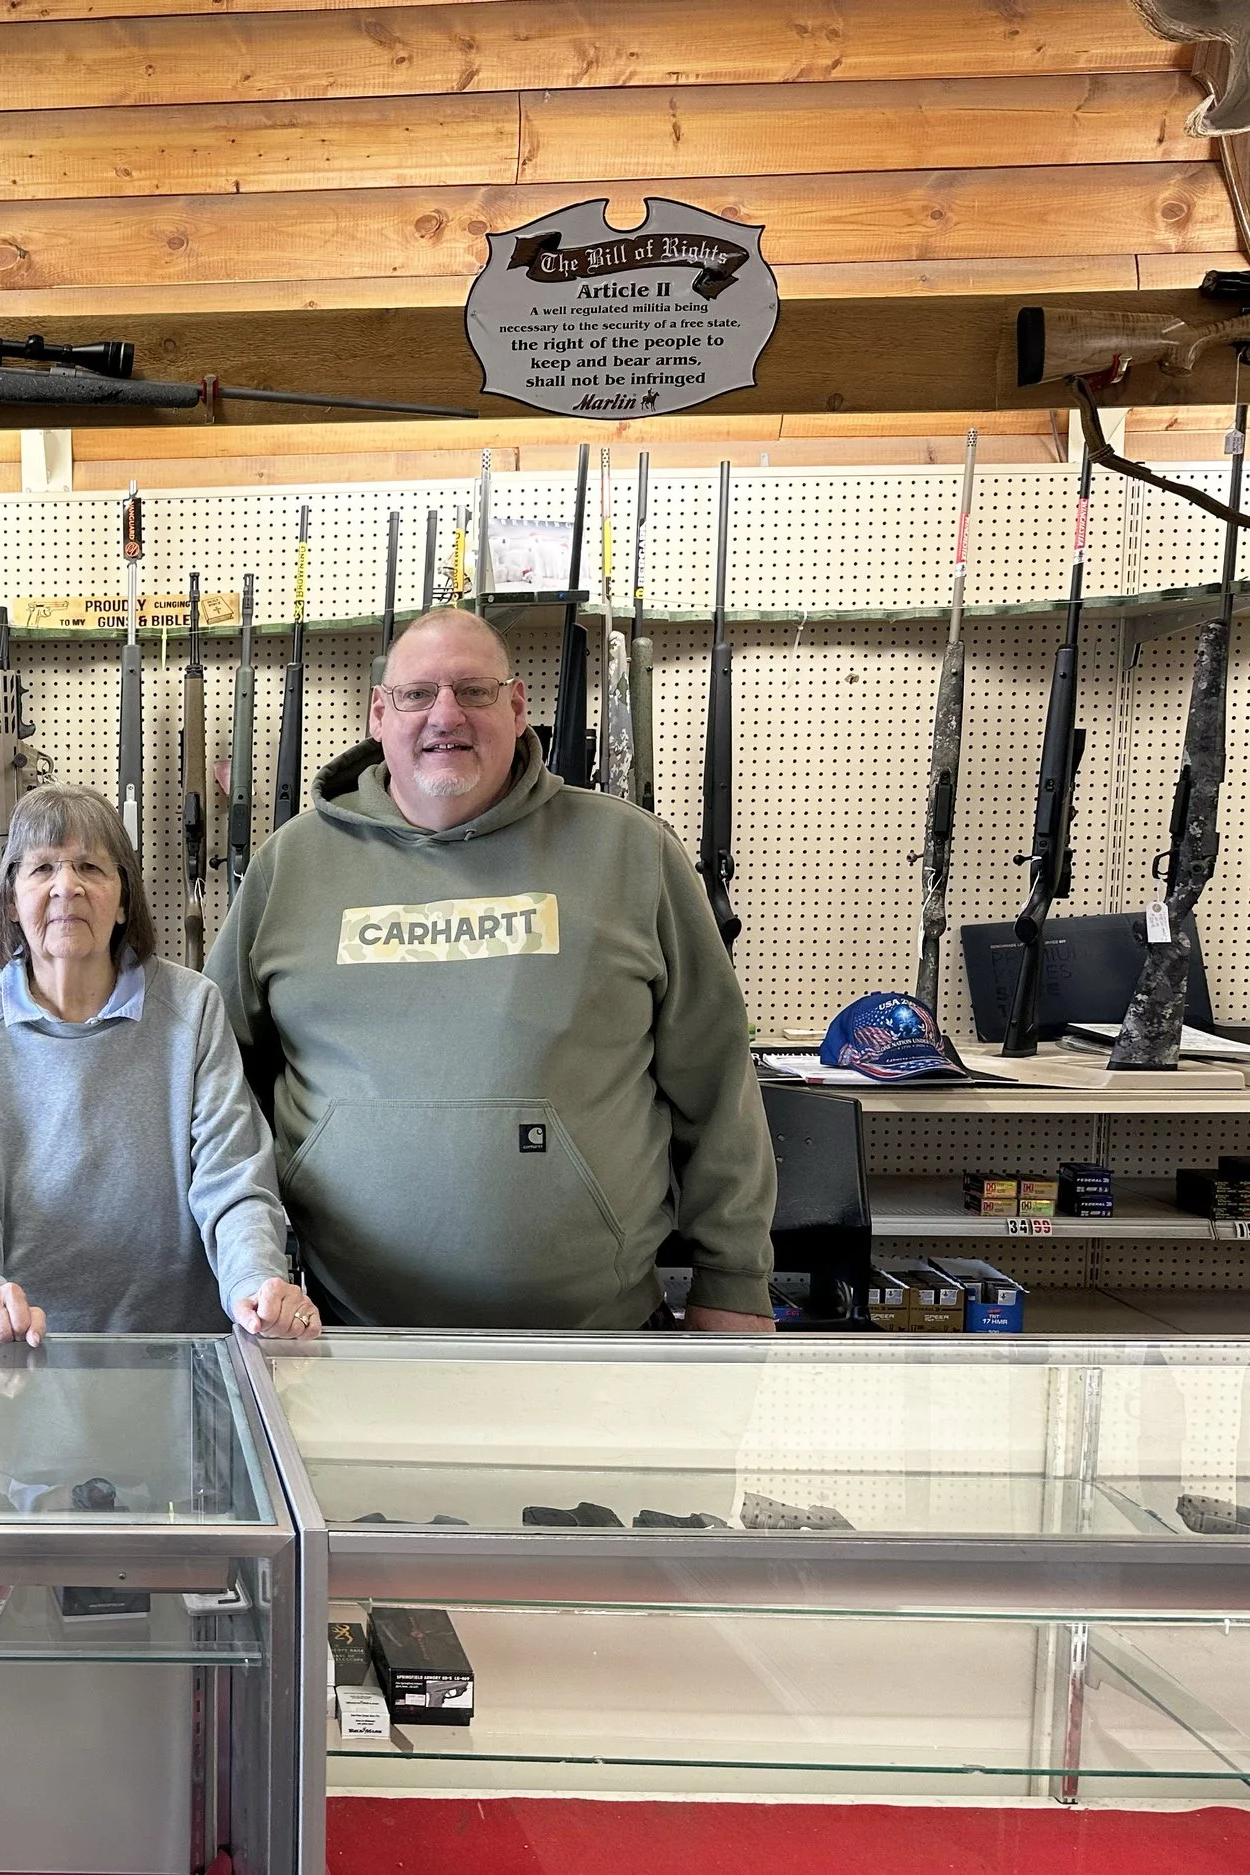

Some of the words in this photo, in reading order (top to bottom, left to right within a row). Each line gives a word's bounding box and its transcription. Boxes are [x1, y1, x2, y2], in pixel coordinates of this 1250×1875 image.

[540, 252, 578, 277] The
[586, 246, 627, 274] Bill
[635, 240, 653, 260] of
[661, 237, 728, 267] Rights
[577, 282, 650, 299] Article
[656, 282, 670, 297] II
[530, 307, 539, 316] A
[543, 306, 567, 315] well
[571, 304, 628, 316] regulated
[633, 303, 670, 313] militia
[675, 302, 708, 314] being
[500, 324, 559, 333] necessary
[563, 322, 575, 331] to
[579, 321, 598, 330] the
[602, 320, 650, 332] security
[654, 319, 667, 328] of
[680, 318, 704, 328] free
[707, 317, 740, 329] state,
[511, 339, 538, 351] the
[543, 337, 584, 352] right
[590, 336, 606, 349] of
[611, 336, 639, 348] the
[644, 335, 701, 350] people
[706, 335, 724, 346] to
[531, 357, 571, 371] keep
[576, 356, 607, 368] and
[613, 355, 650, 367] bear
[655, 355, 702, 367] arms,
[526, 375, 565, 387] shall
[571, 374, 599, 386] not
[605, 374, 625, 386] be
[630, 372, 705, 387] infringed
[572, 393, 637, 410] Marlin
[85, 600, 146, 612] PROUDY
[138, 616, 147, 626] &
[358, 908, 537, 946] CARHARTT
[878, 998, 900, 1010] USA
[891, 1039, 912, 1047] NATION
